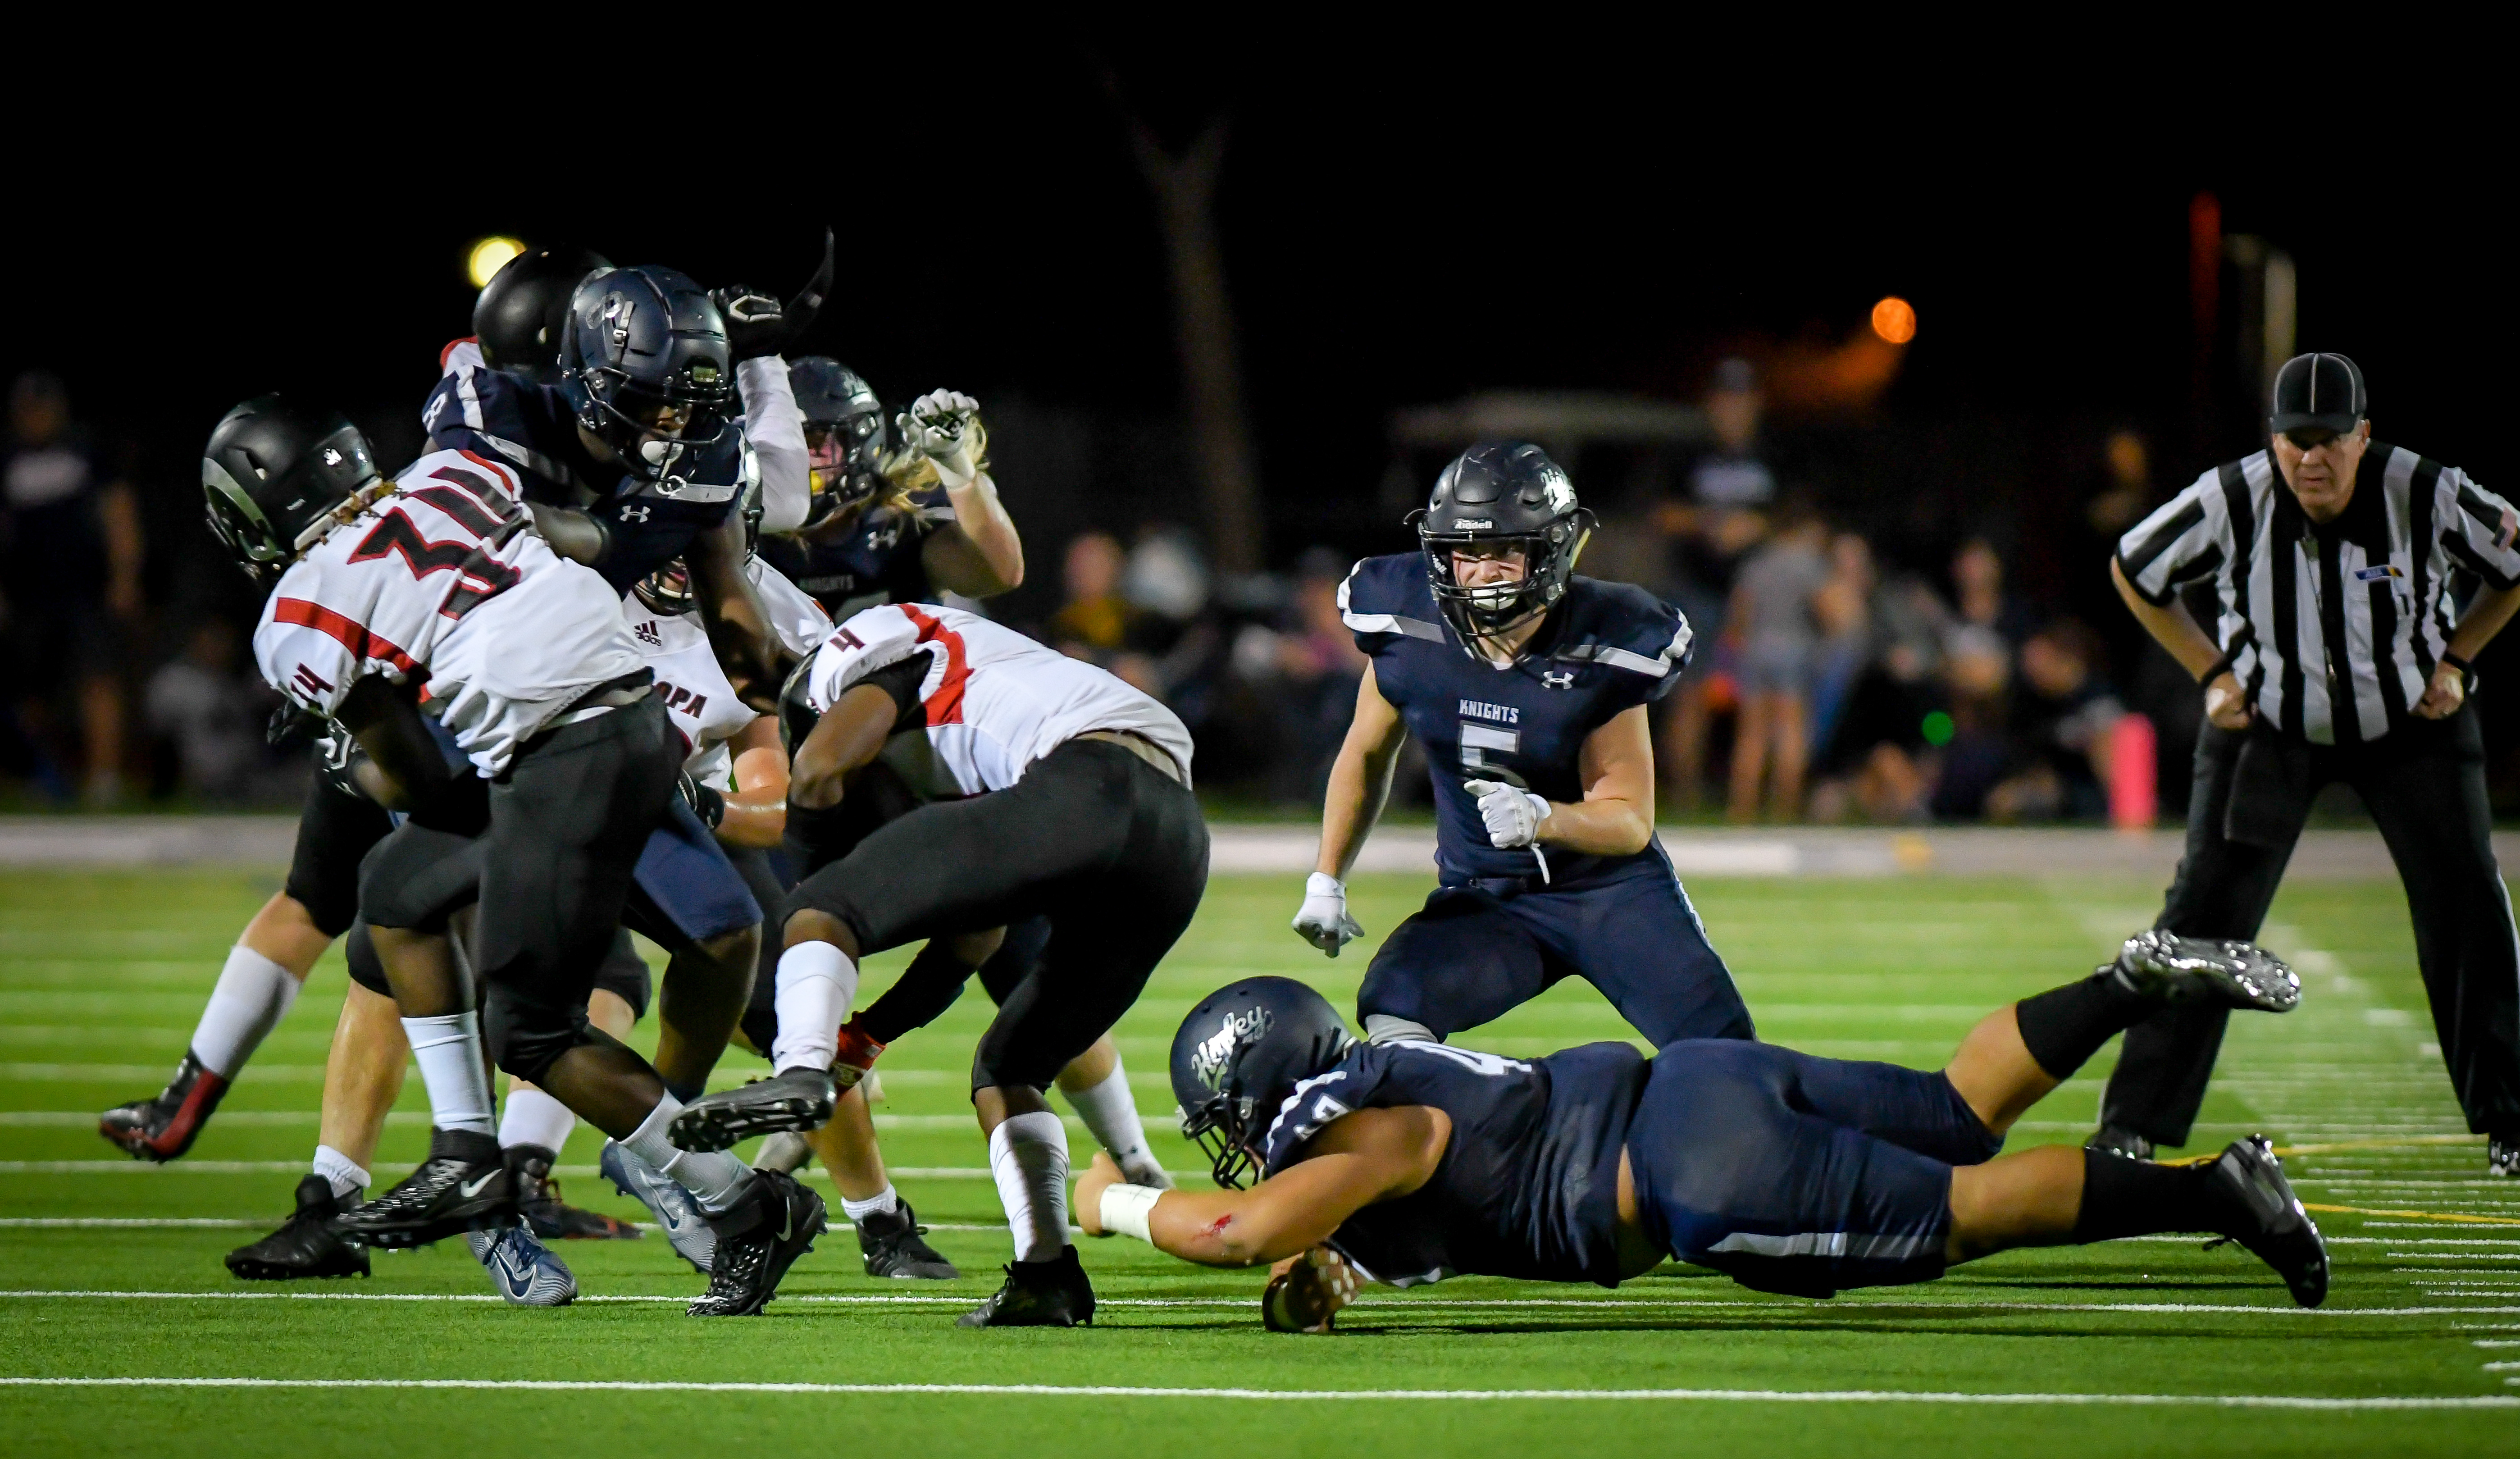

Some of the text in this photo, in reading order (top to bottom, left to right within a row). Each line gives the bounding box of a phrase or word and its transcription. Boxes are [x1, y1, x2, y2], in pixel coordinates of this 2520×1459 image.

[829, 626, 866, 652] 4
[1458, 699, 1519, 724] KNIGHTS
[1458, 720, 1531, 792] 5
